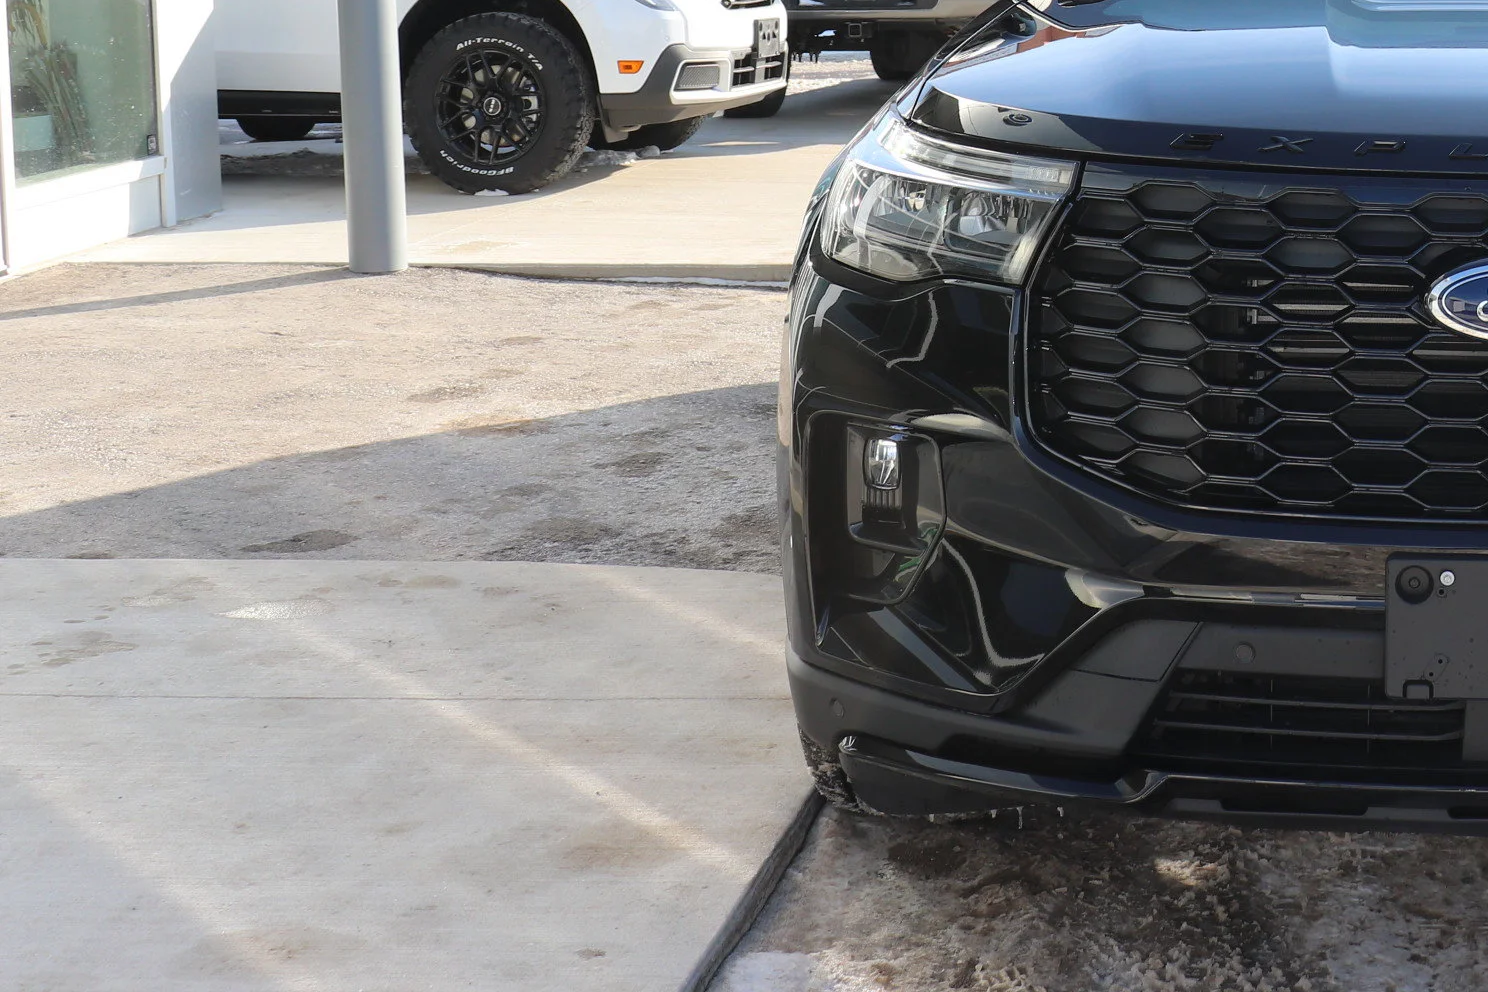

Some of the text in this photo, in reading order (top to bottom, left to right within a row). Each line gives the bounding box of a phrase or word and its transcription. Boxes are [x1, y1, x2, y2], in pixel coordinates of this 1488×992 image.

[455, 36, 544, 71] All-Terrain T/A
[439, 149, 515, 176] BFGoodrich
